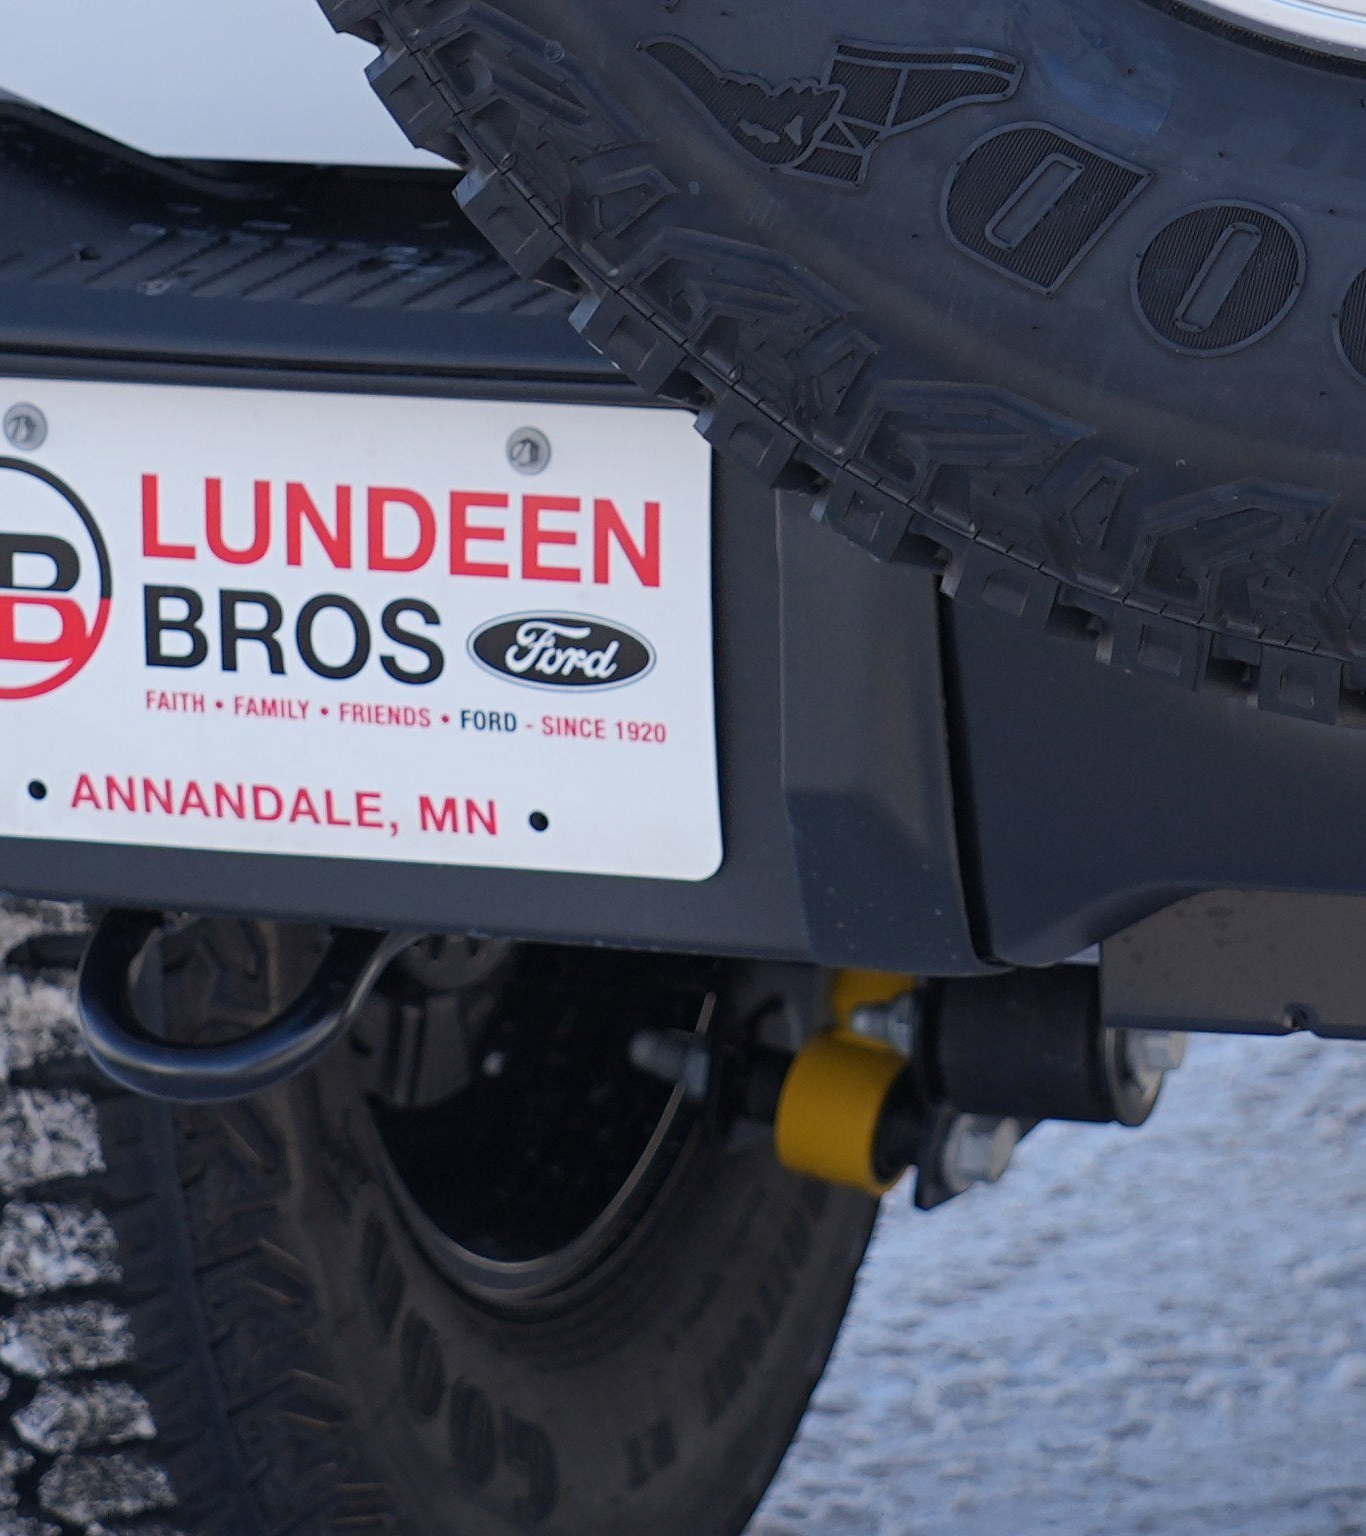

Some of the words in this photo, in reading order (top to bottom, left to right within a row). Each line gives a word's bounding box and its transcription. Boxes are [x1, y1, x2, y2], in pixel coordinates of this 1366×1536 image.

[141, 472, 662, 588] LUNDEEN
[143, 583, 446, 686] BROS
[504, 619, 620, 681] Ford
[145, 689, 206, 714] FAITH
[234, 694, 310, 721] FAMILY
[338, 700, 432, 728] FRIENDS
[460, 708, 518, 733] FORD
[541, 715, 607, 740] SINCE
[614, 720, 668, 744] 1920
[70, 772, 399, 838] ANNANDALE,
[418, 794, 499, 836] MN
